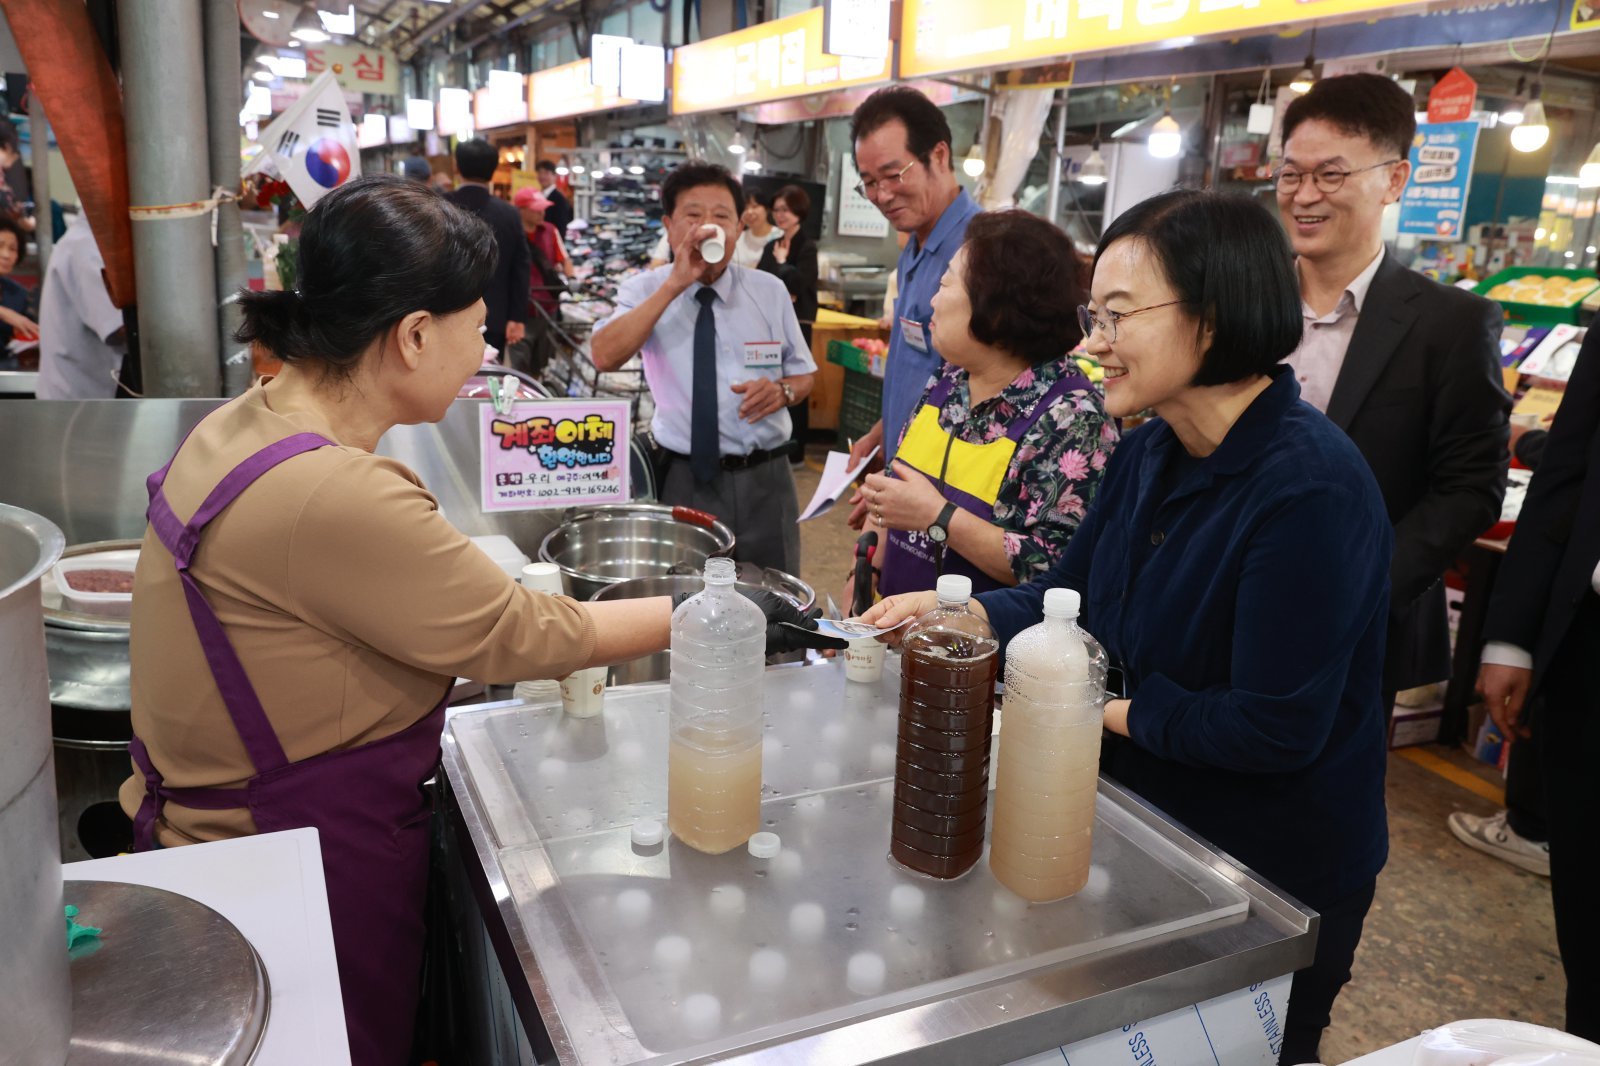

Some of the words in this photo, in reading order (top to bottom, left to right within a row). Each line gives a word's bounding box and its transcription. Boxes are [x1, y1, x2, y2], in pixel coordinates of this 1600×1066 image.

[492, 415, 615, 449] 계좌이체
[537, 445, 612, 469] 환영합니다
[496, 473, 523, 486] 은행
[1254, 991, 1283, 1055] STAINLESS
